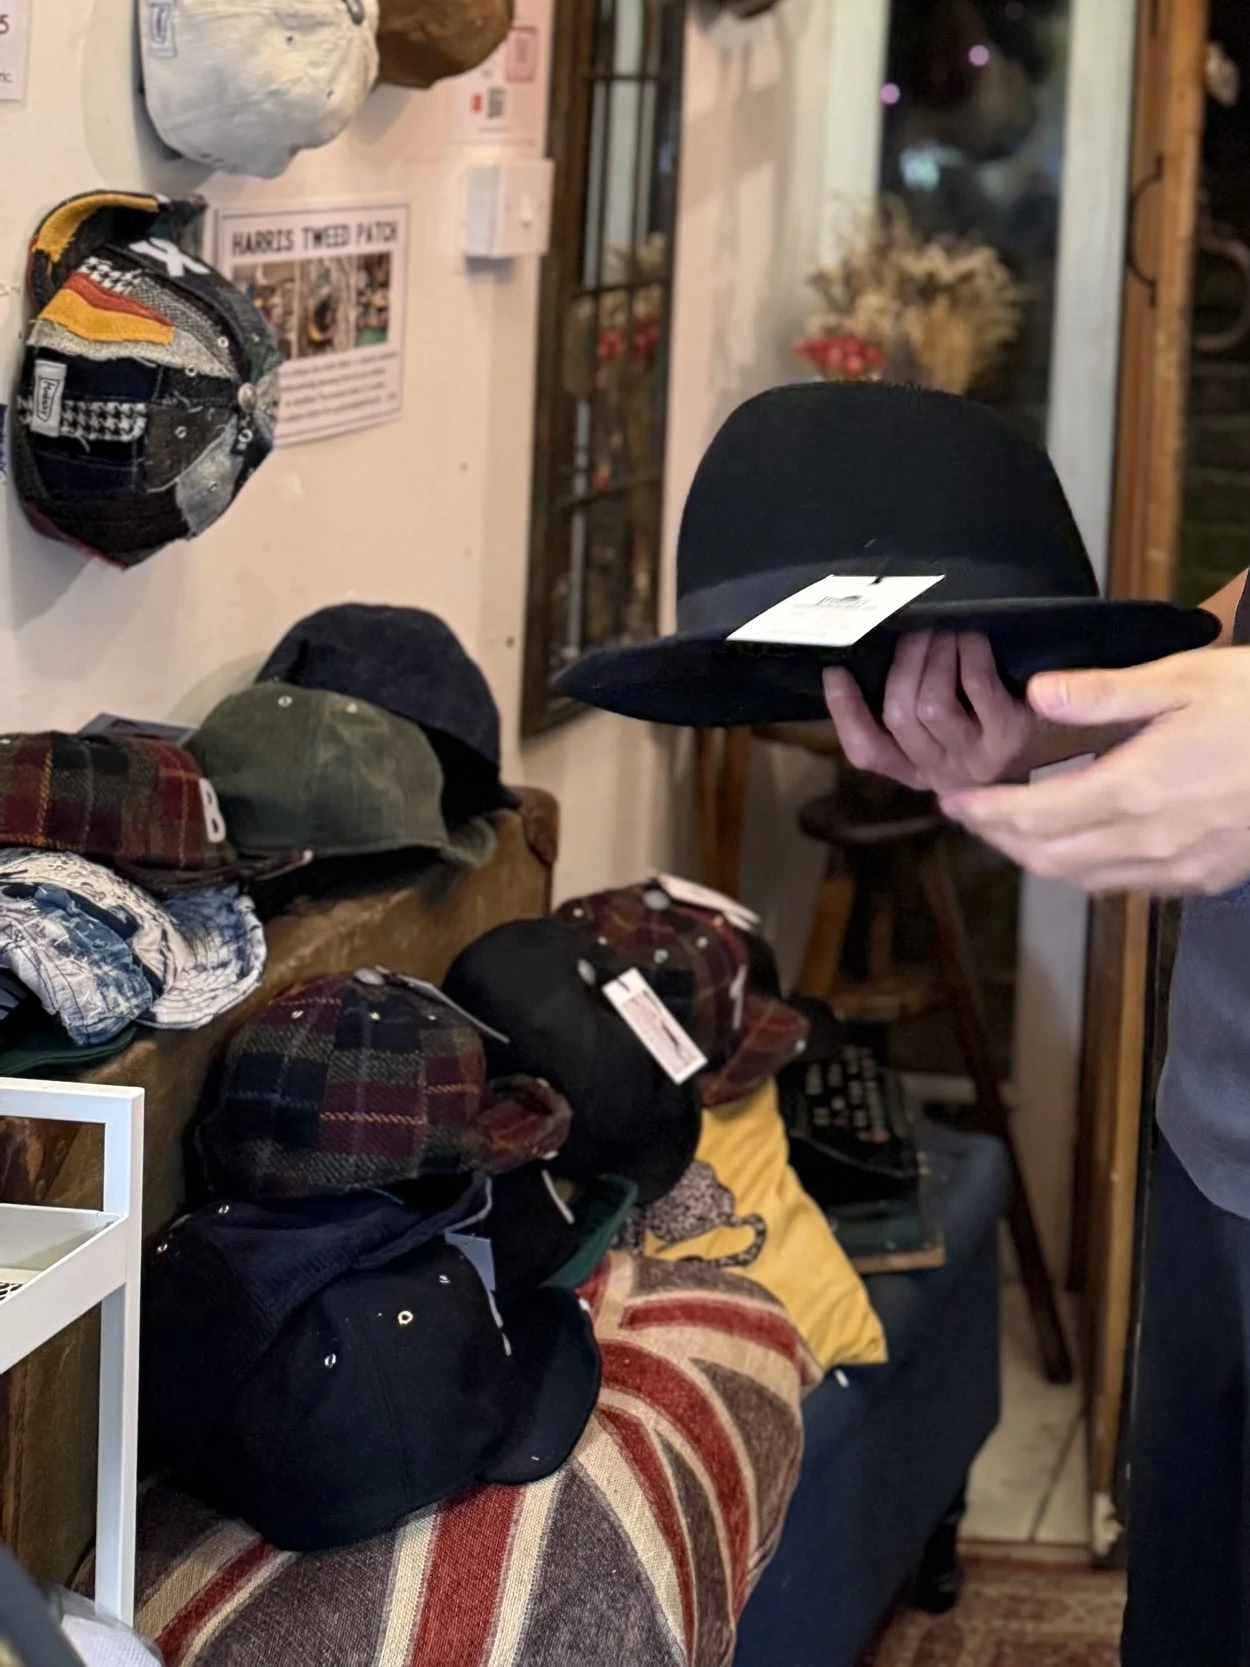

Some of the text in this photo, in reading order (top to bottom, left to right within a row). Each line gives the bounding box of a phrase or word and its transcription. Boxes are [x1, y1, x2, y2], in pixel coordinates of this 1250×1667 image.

[231, 228, 294, 256] HARRIS
[302, 223, 351, 250] TWEED
[199, 777, 226, 842] B
